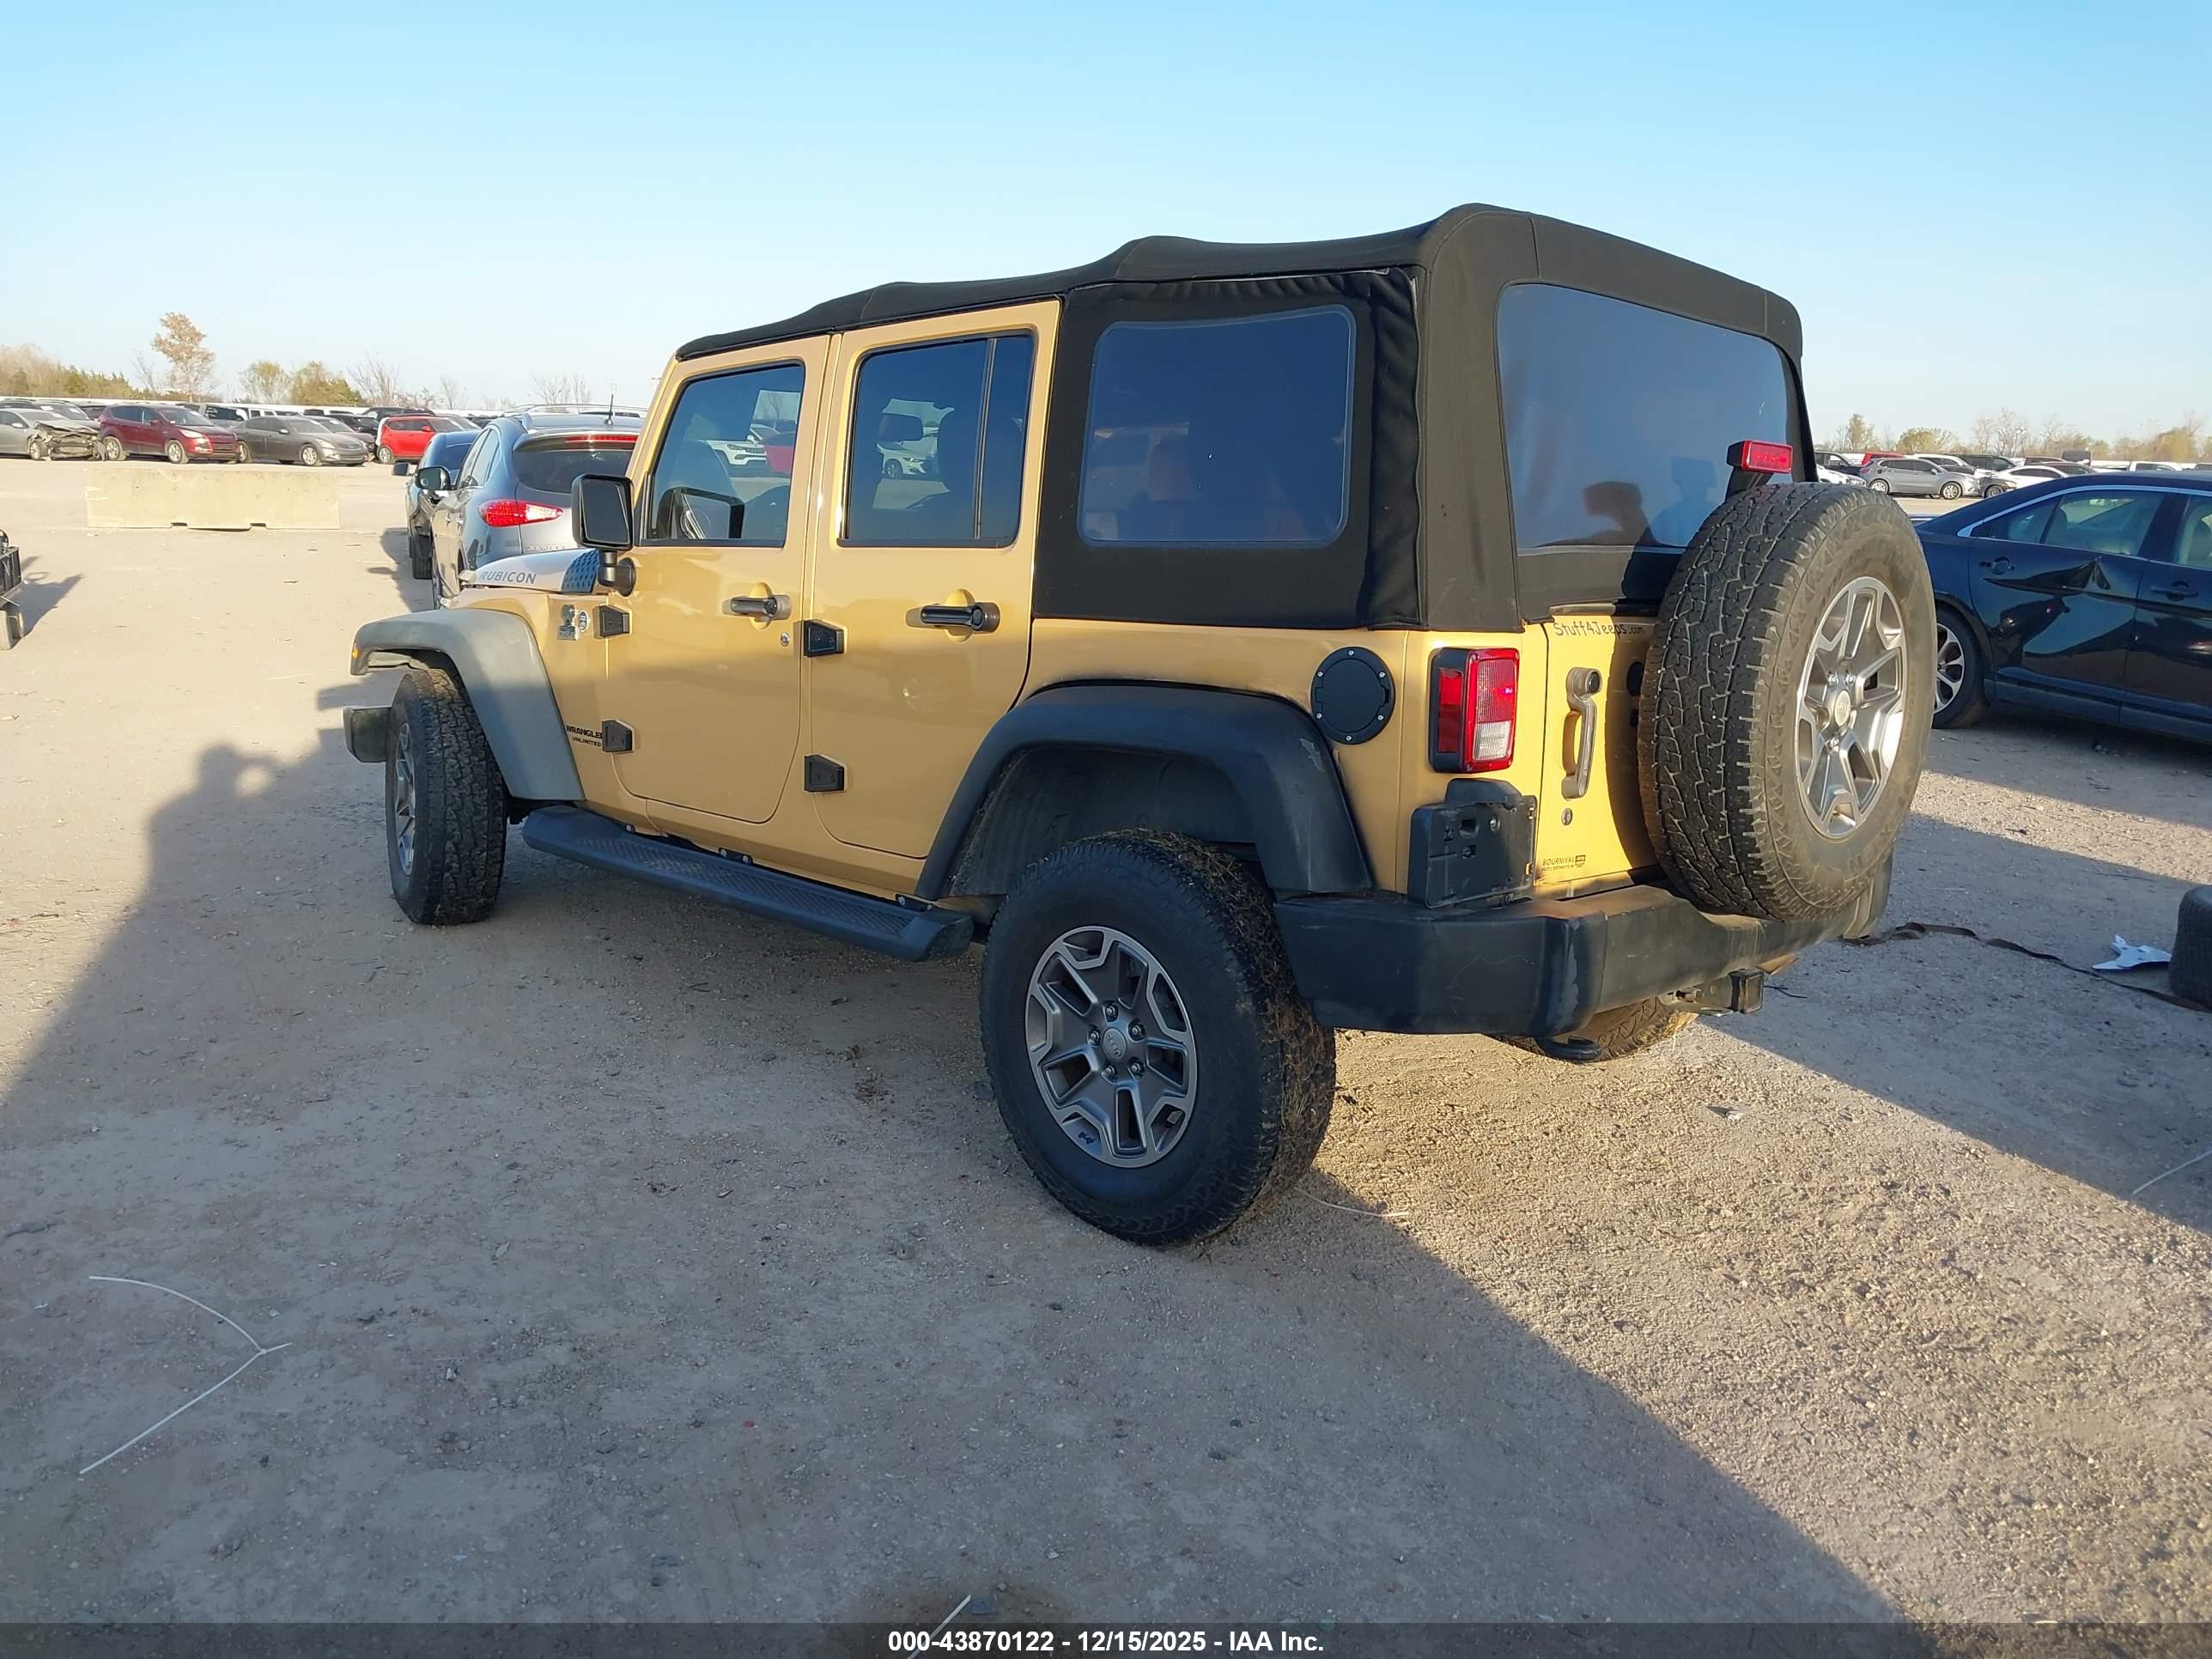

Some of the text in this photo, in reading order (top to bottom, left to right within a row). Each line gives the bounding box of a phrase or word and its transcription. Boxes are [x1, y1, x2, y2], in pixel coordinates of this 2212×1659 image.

[479, 570, 537, 584] RUBICON
[1553, 621, 1644, 639] Stuff4Jeeps.com
[572, 736, 602, 747] UNLIMITED
